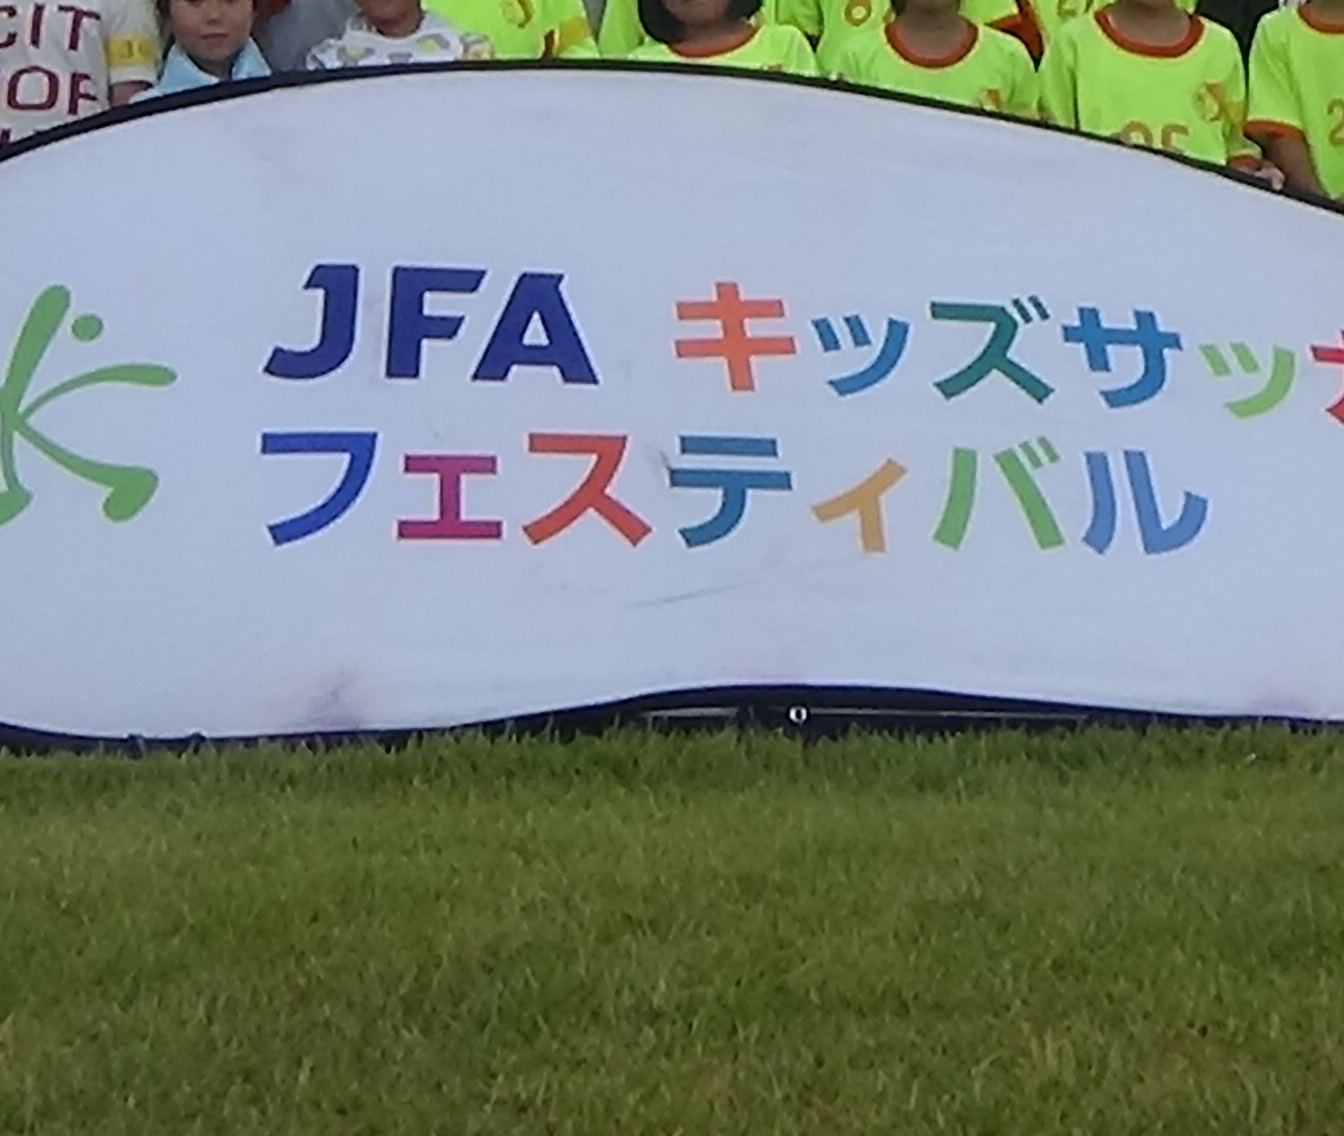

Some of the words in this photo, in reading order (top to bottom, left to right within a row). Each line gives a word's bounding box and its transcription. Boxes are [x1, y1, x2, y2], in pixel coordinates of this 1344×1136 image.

[263, 264, 600, 385] JFA
[259, 431, 1209, 555] フェスティバル
